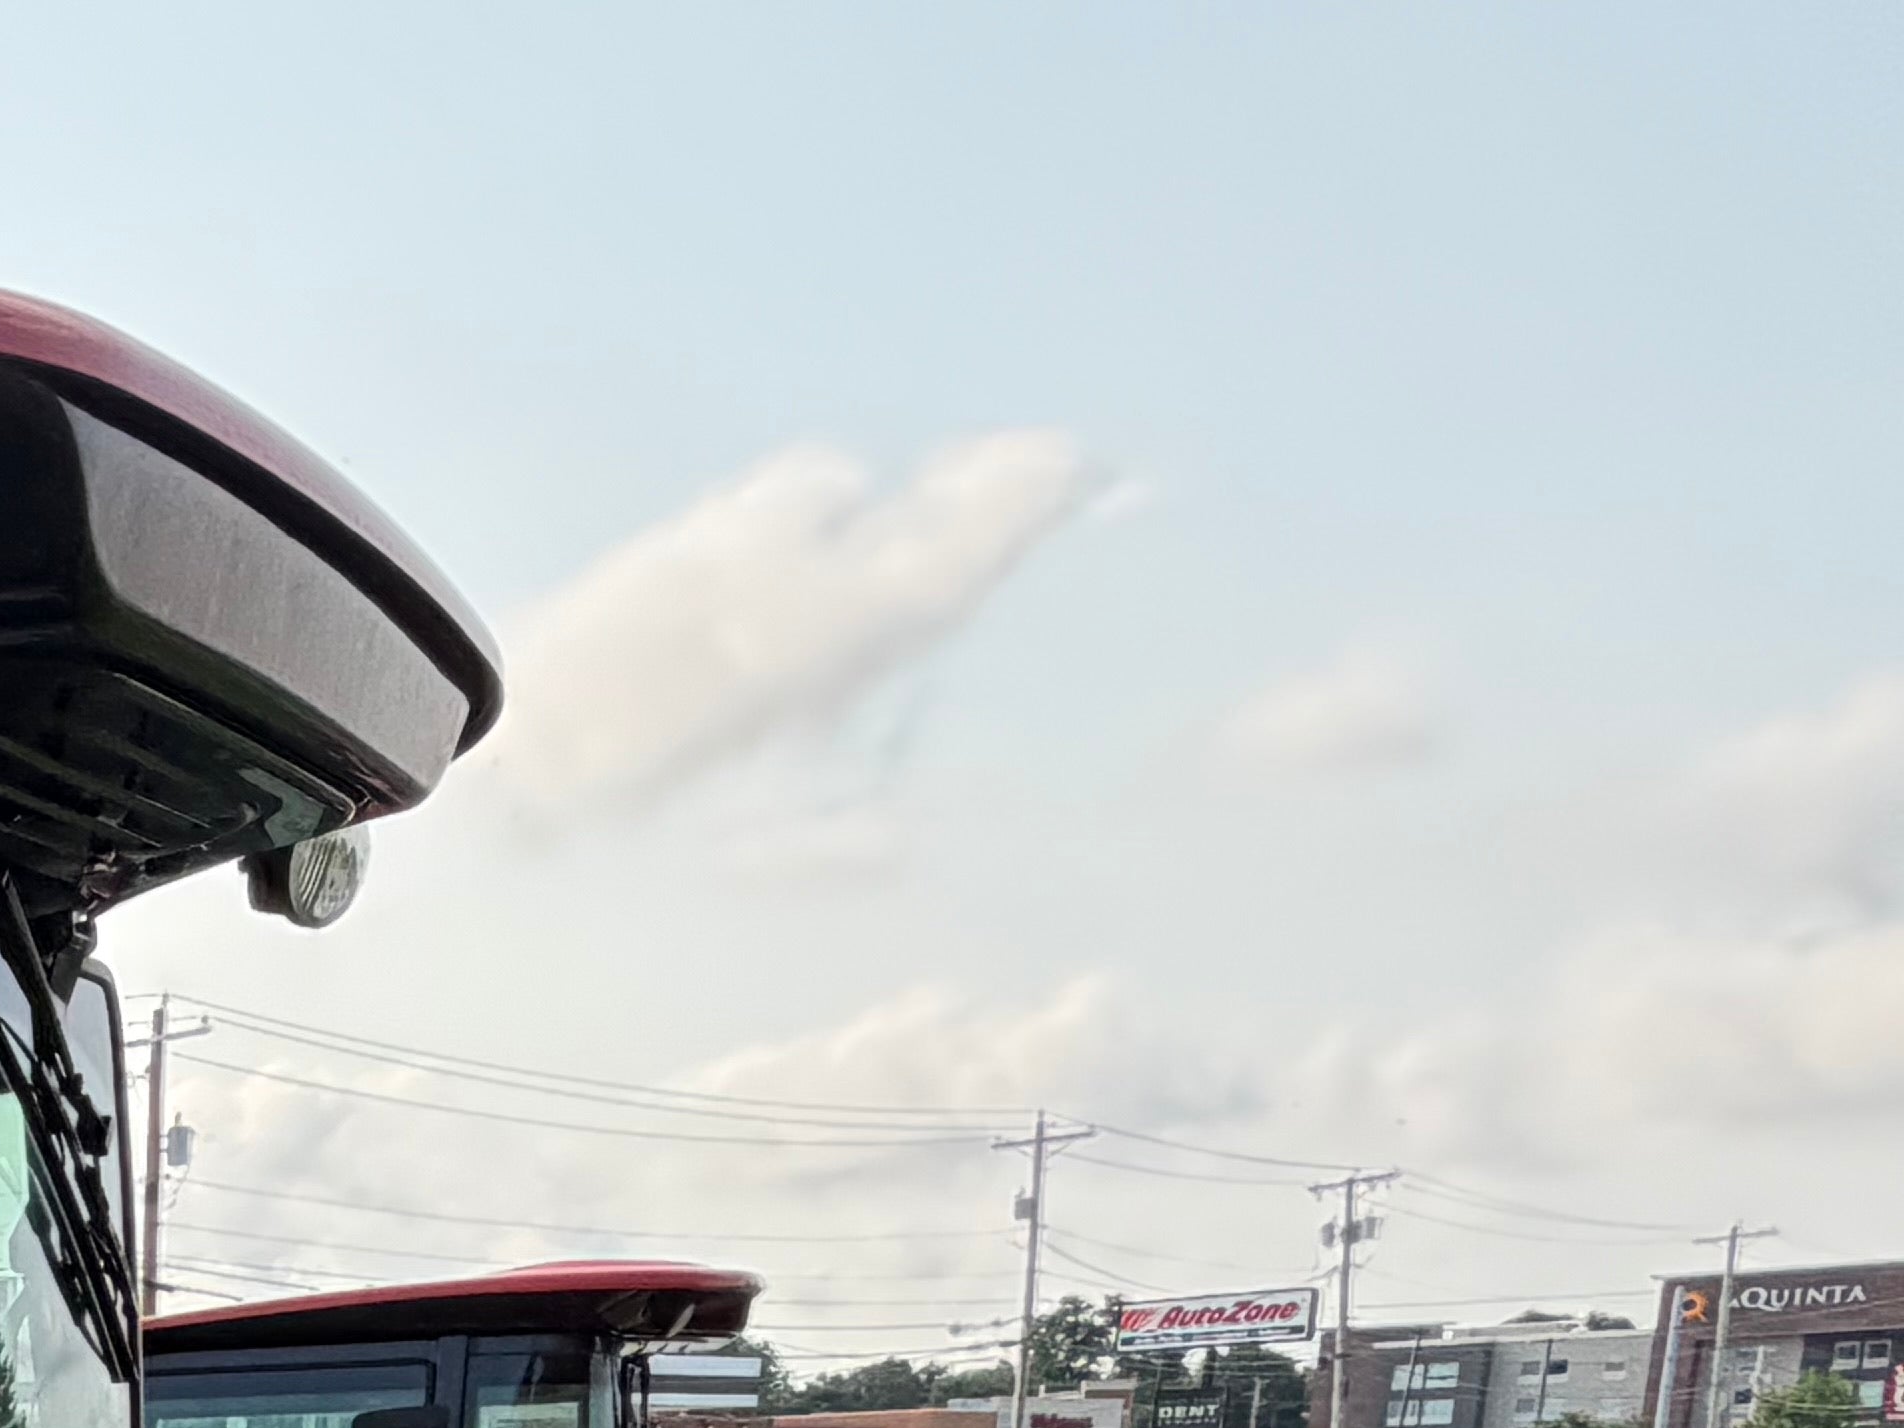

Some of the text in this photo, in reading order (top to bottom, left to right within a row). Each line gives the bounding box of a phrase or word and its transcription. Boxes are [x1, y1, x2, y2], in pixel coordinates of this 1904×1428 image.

[1728, 1285, 1867, 1312] QUINTA
[1158, 1300, 1301, 1330] AutoZone
[1158, 1404, 1220, 1419] DENT
